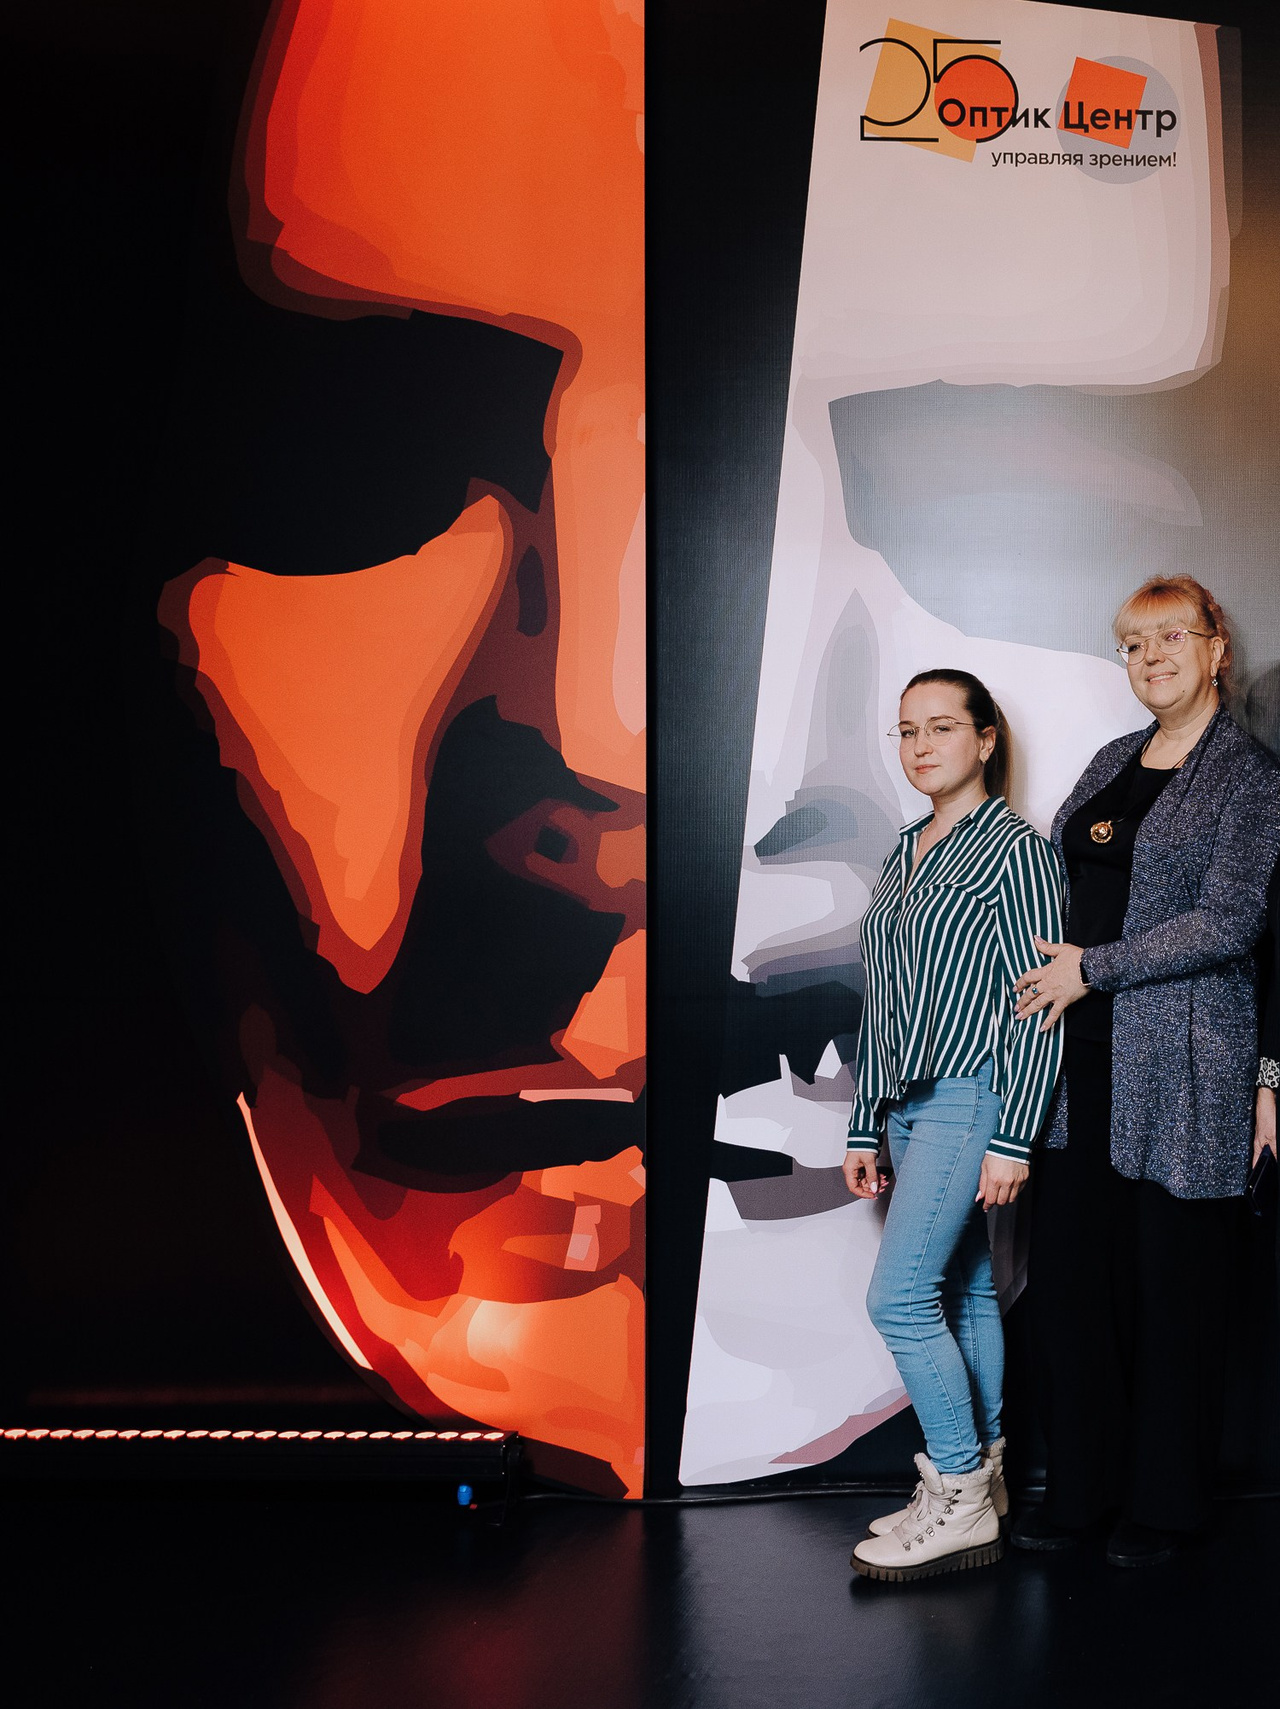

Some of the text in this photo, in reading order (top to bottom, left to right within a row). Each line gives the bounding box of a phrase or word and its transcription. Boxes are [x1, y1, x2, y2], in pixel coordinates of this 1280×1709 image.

[860, 37, 1019, 143] 25
[938, 98, 1177, 137] Оптик Центр
[991, 150, 1177, 168] управляя зрением!
